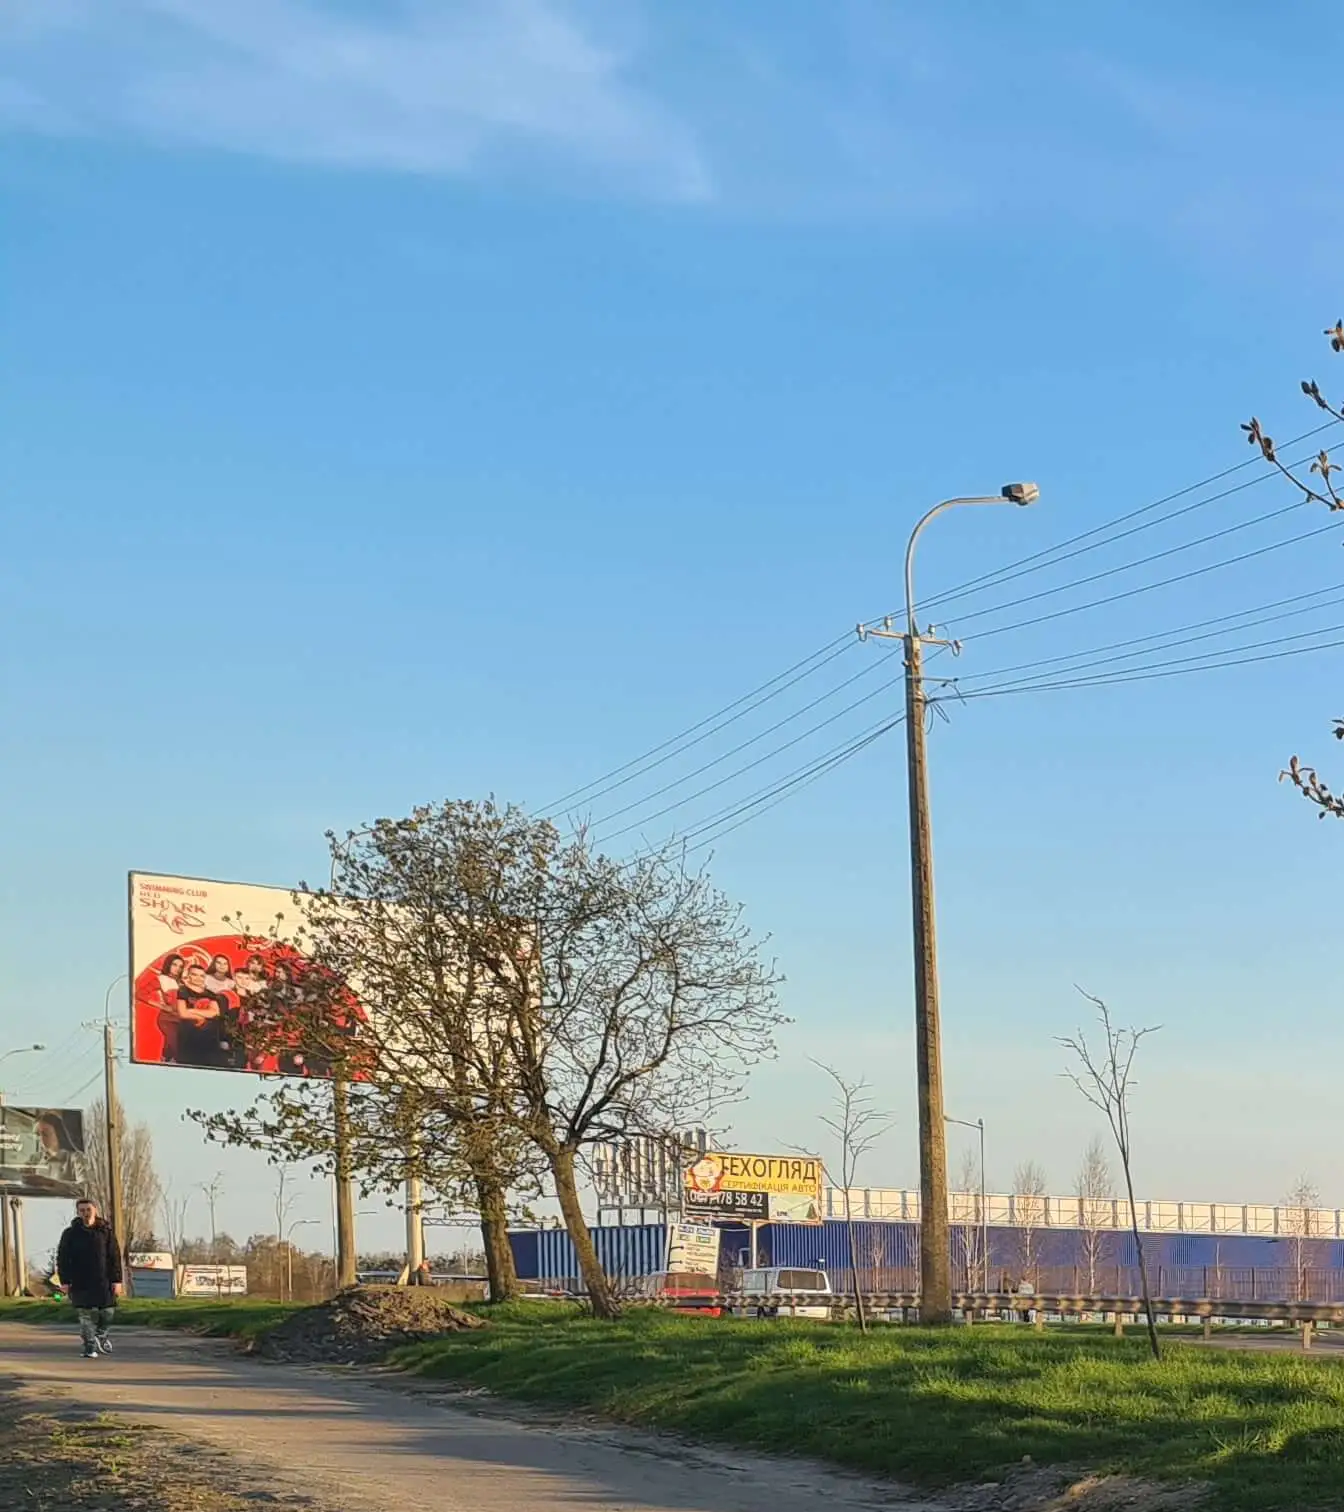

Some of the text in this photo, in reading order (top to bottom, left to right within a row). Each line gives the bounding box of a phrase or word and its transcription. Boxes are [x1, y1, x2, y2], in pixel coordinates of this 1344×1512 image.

[186, 888, 208, 898] CLUB
[719, 1156, 817, 1184] ТЕХОГЛЯД
[791, 1182, 817, 1193] АВТО
[750, 1193, 763, 1207] 42
